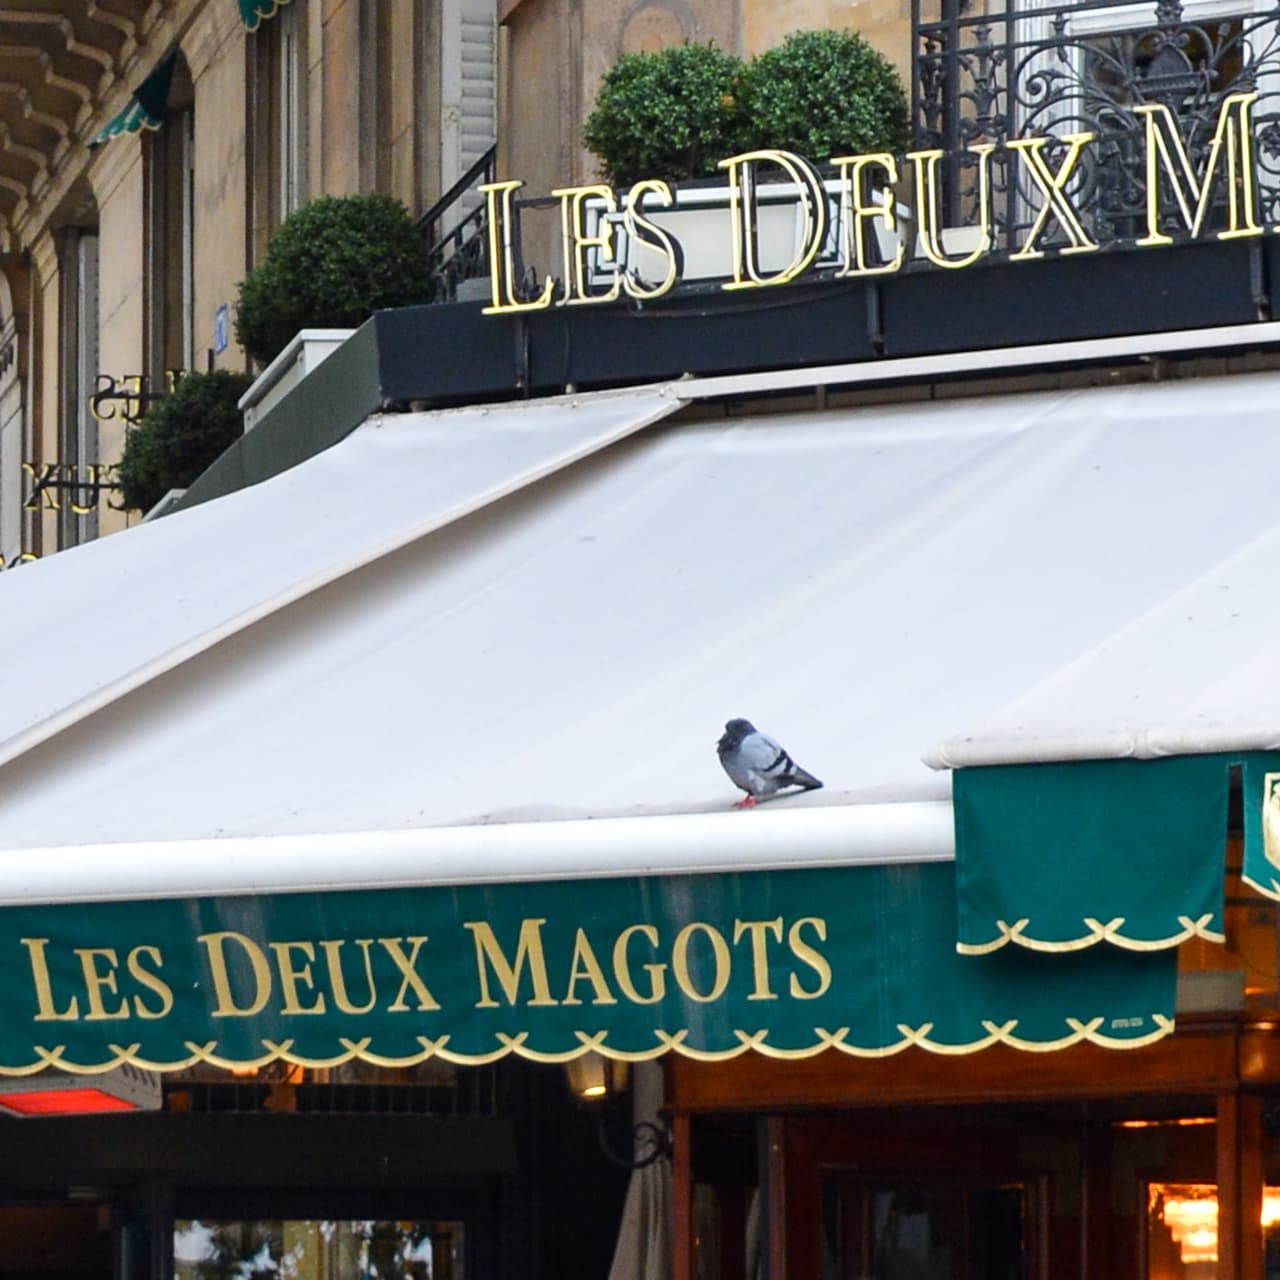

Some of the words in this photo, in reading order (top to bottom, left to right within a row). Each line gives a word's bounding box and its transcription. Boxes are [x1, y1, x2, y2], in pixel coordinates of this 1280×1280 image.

[476, 179, 680, 315] LES
[717, 131, 1102, 291] DEUX
[19, 937, 174, 1021] LES
[196, 930, 442, 1017] DEUX
[463, 916, 833, 1009] MAGOTS
